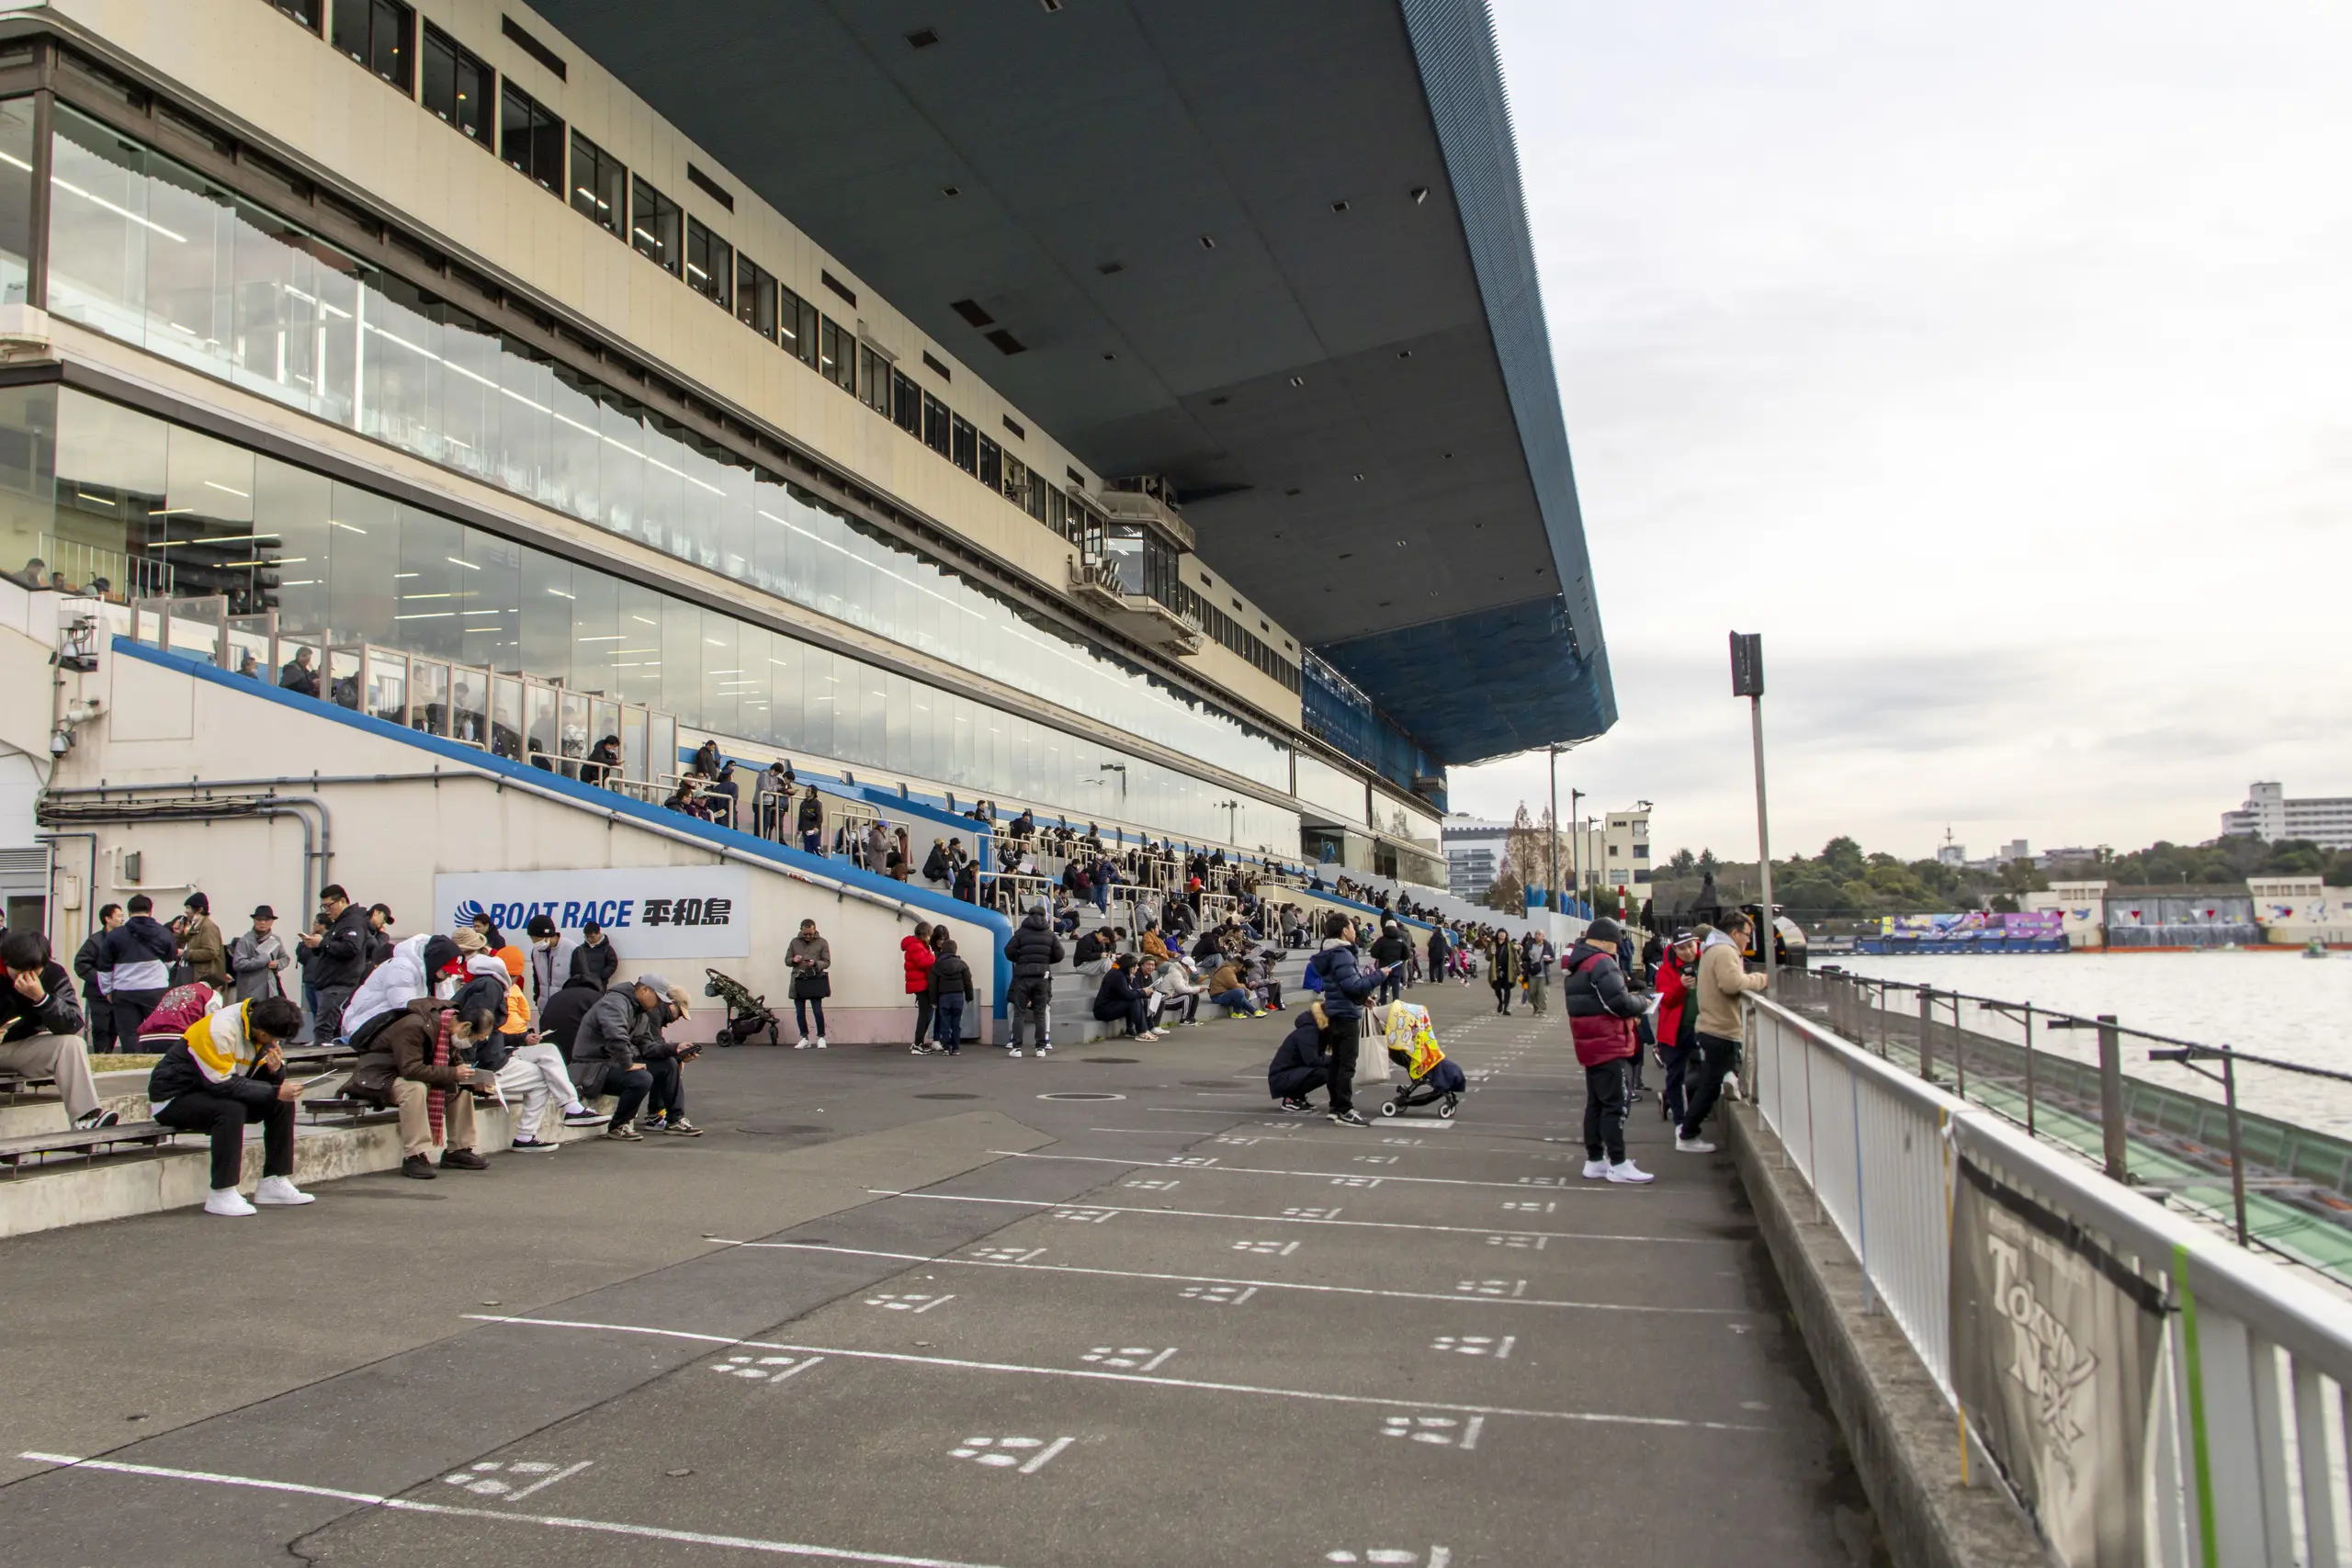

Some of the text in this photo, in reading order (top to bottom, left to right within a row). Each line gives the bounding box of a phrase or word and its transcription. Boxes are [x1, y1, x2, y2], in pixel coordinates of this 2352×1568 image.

[489, 897, 732, 931] BOAT RACE 平和島
